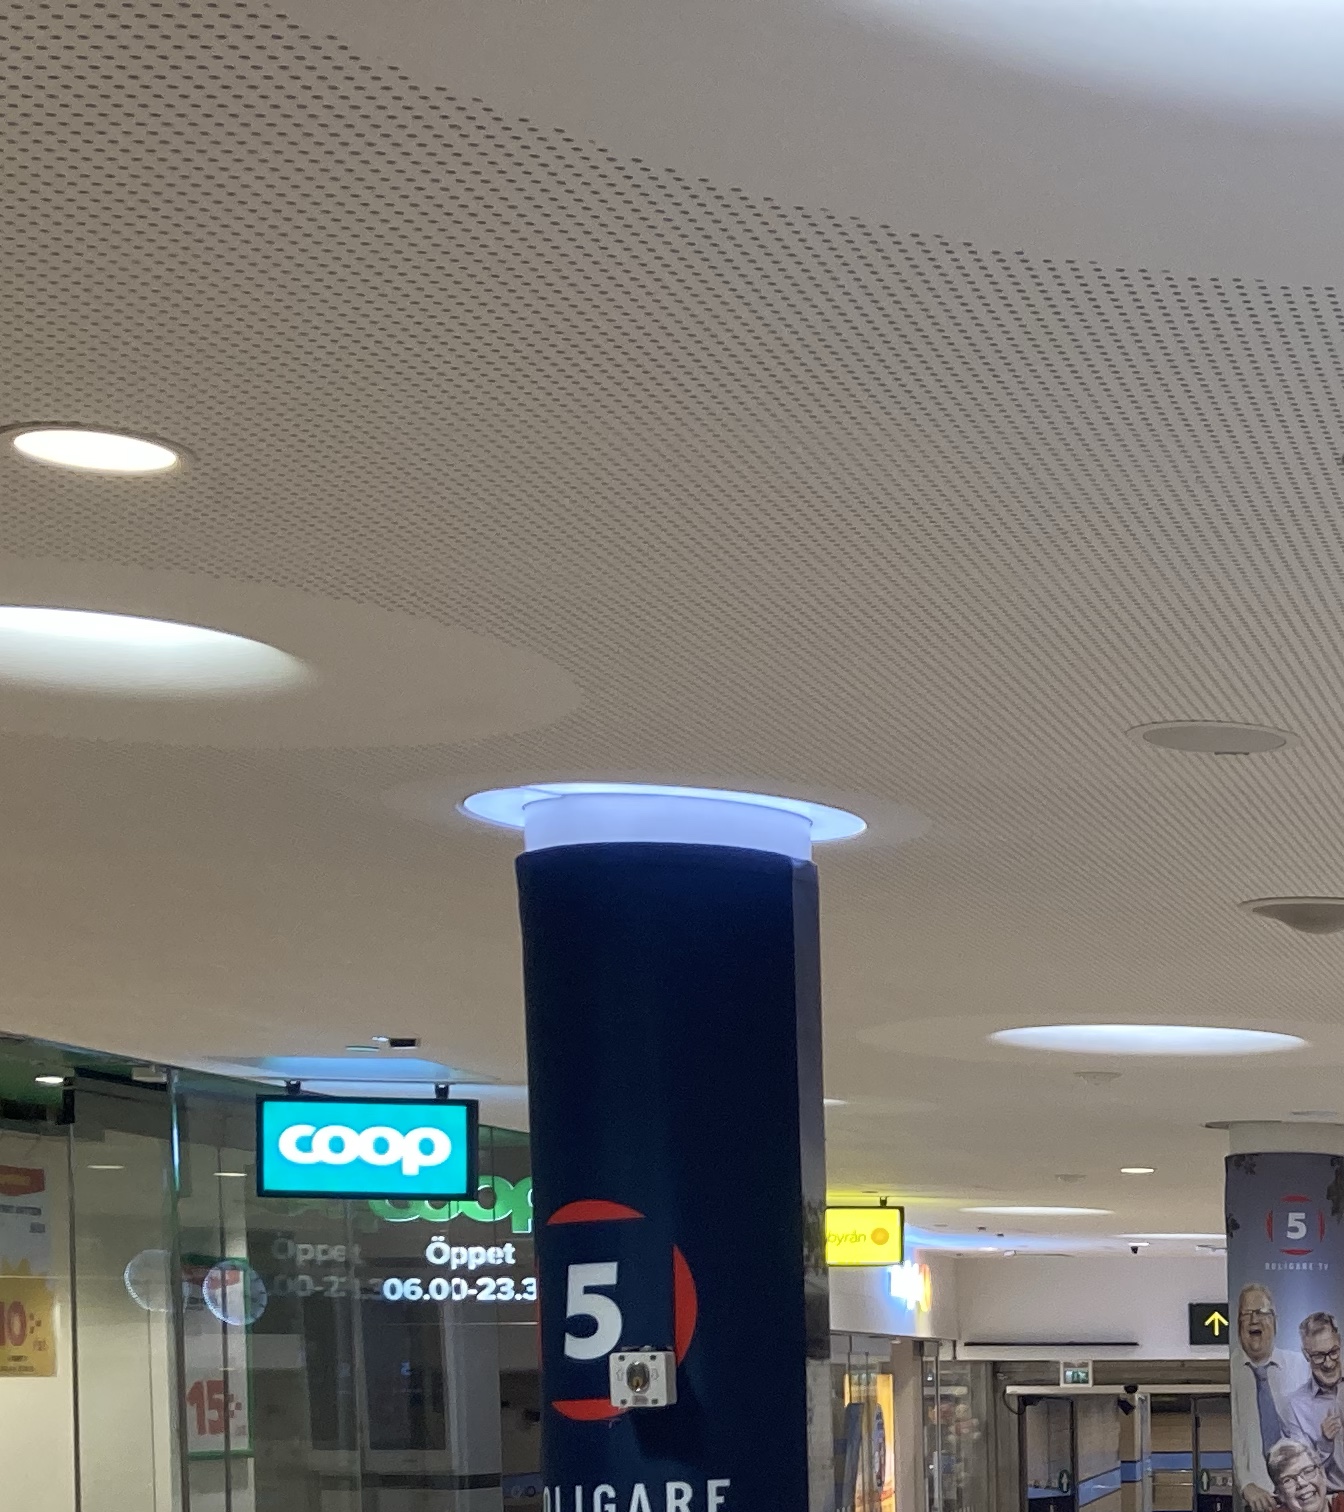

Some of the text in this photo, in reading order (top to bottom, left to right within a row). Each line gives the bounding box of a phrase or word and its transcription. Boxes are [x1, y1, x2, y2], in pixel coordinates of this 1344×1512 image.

[278, 1124, 452, 1176] coop
[827, 1229, 867, 1246] byrån
[1286, 1212, 1307, 1240] 5
[425, 1236, 516, 1270] Öppet
[563, 1261, 623, 1361] 5
